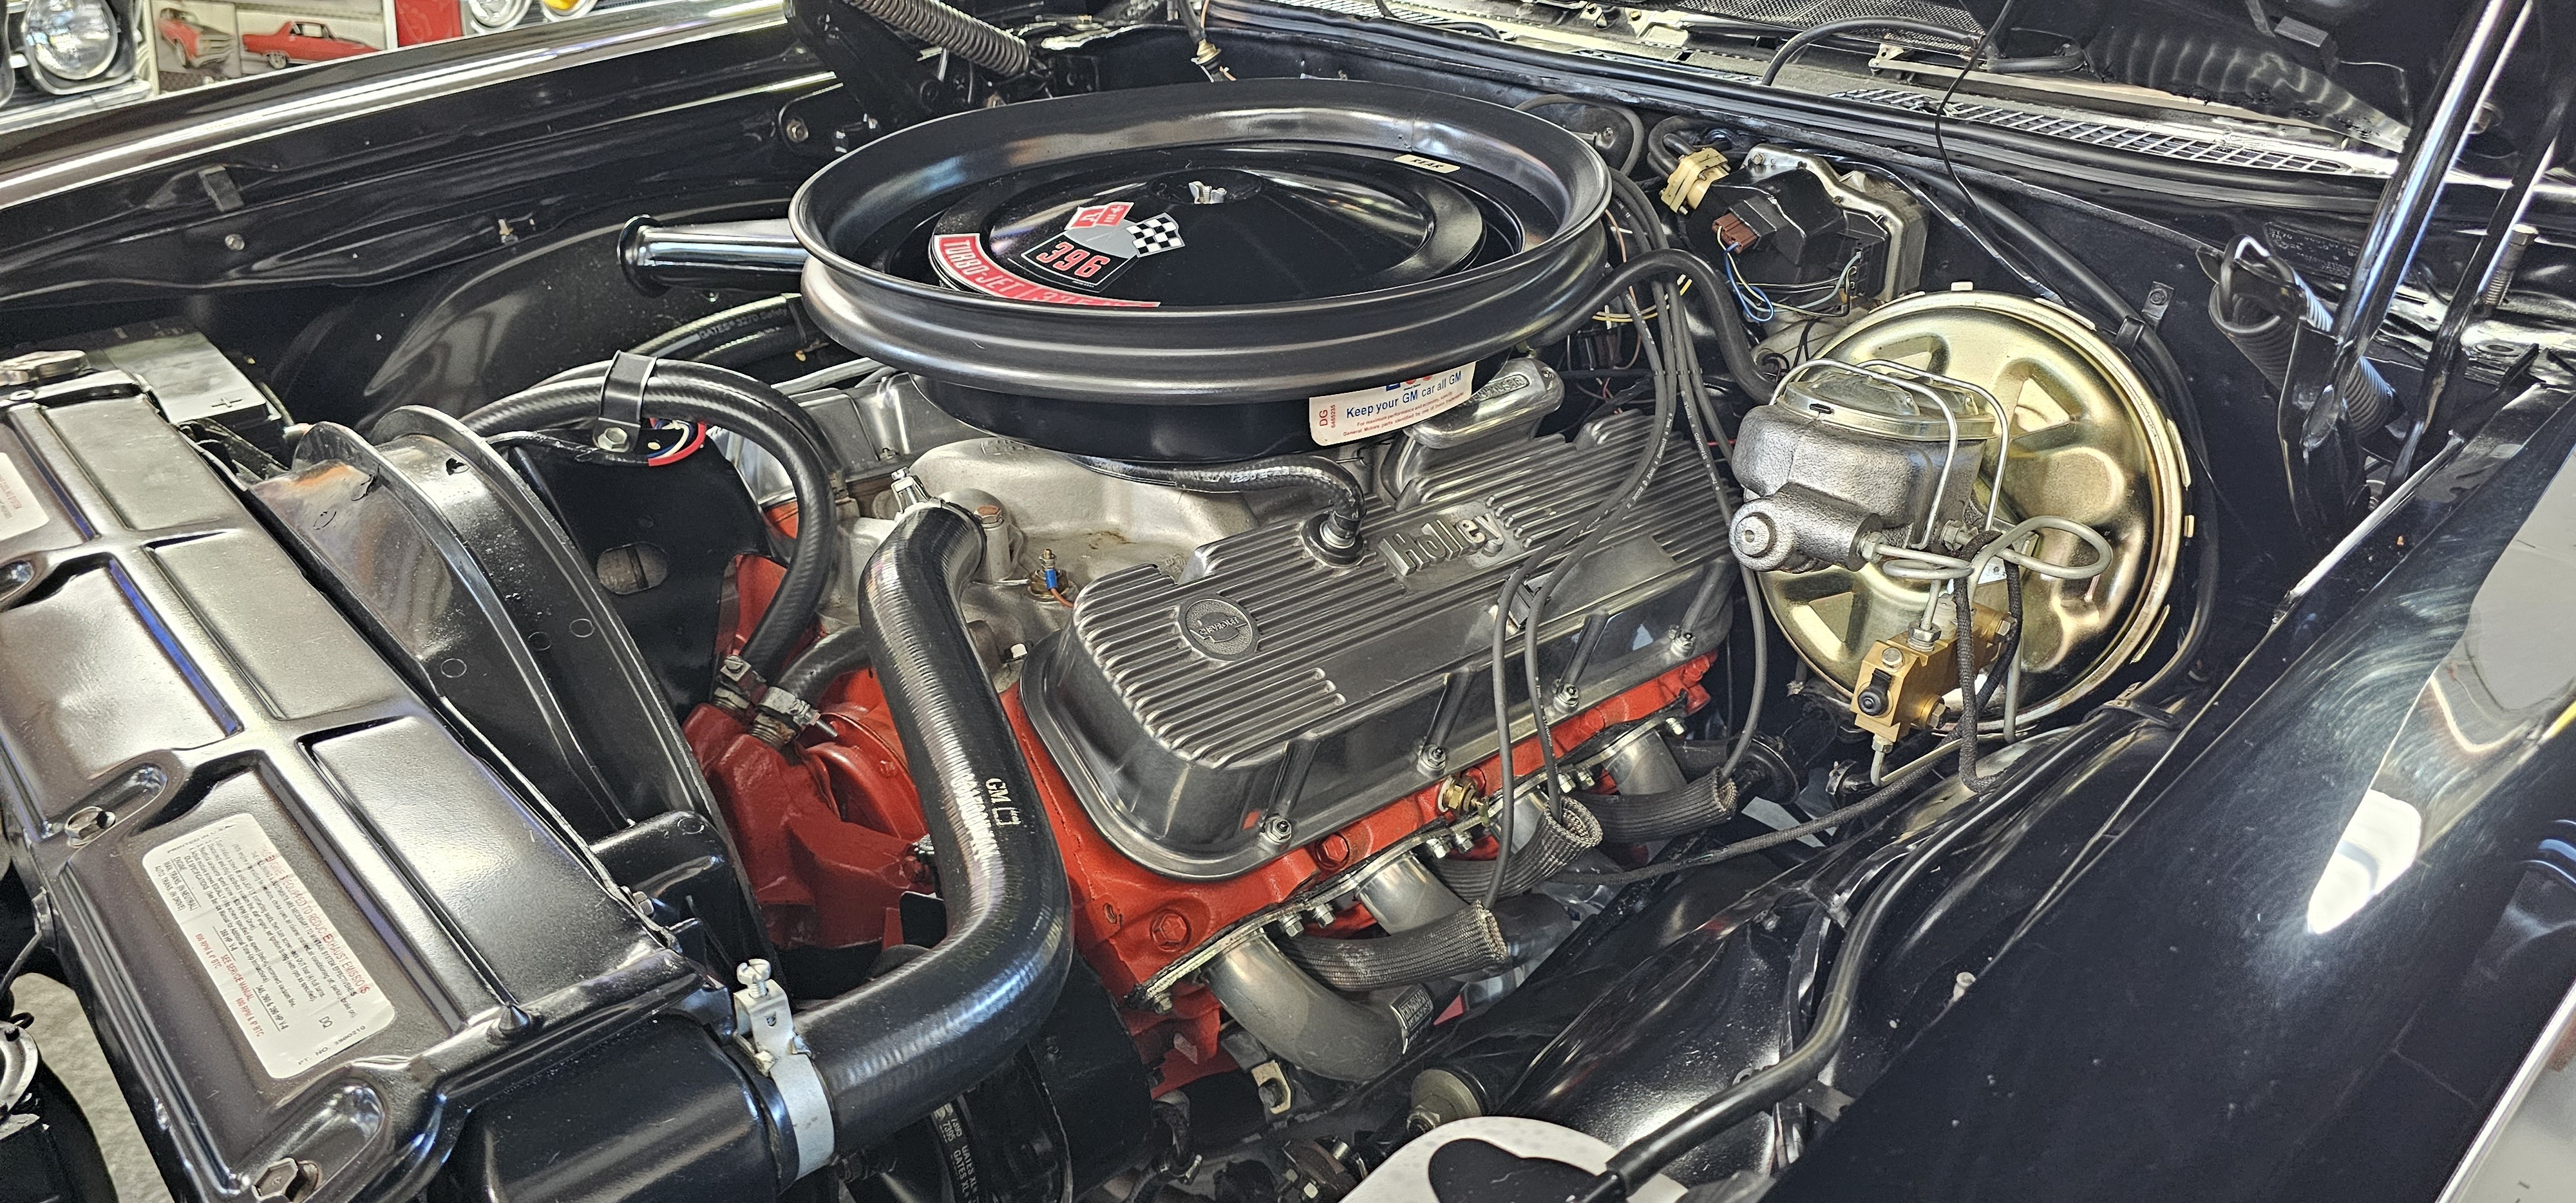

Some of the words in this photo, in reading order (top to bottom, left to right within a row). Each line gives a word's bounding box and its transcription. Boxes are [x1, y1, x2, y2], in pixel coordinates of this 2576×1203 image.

[1409, 157, 1444, 169] REAR
[943, 239, 1025, 292] TURBO-JET
[1036, 242, 1111, 278] 396
[1347, 406, 1374, 419] Keep
[1376, 398, 1399, 414] your
[1403, 389, 1418, 404] GM
[1421, 385, 1436, 397] car
[1437, 379, 1447, 393] all
[1449, 370, 1462, 385] GM
[1319, 409, 1329, 427] DG
[1343, 428, 1363, 437] General
[1381, 421, 1394, 429] parts
[1394, 414, 1414, 424] identified
[1366, 415, 1387, 426] maximum
[1387, 407, 1415, 421] performance
[1693, 431, 1708, 460] STANDARD
[1378, 513, 1505, 576] Holley
[1197, 615, 1240, 636] CHEVROLET
[985, 777, 1012, 804] GM
[172, 856, 187, 872] ENGINE
[160, 876, 175, 893] TRANS.
[171, 895, 187, 912] DRIVE)
[167, 870, 183, 886] TRANS.
[178, 889, 198, 912] NEUTRAL)
[300, 904, 314, 915] TO
[321, 933, 350, 964] EXHAUST
[199, 939, 213, 952] RPM
[210, 957, 223, 970] BTC
[219, 952, 232, 965] SEE
[225, 961, 245, 984] SERVICE
[321, 949, 337, 967] SYSTEM
[331, 965, 358, 998] EFFECTIVENES
[237, 980, 256, 1003] MANUAL
[239, 1004, 253, 1018] RPM
[251, 1024, 265, 1038] BTC
[319, 1016, 333, 1029] DQ
[315, 1047, 332, 1056] NO.
[943, 1121, 956, 1142] 7395
[953, 1149, 968, 1180] GATES
[961, 1144, 976, 1175] GATES
